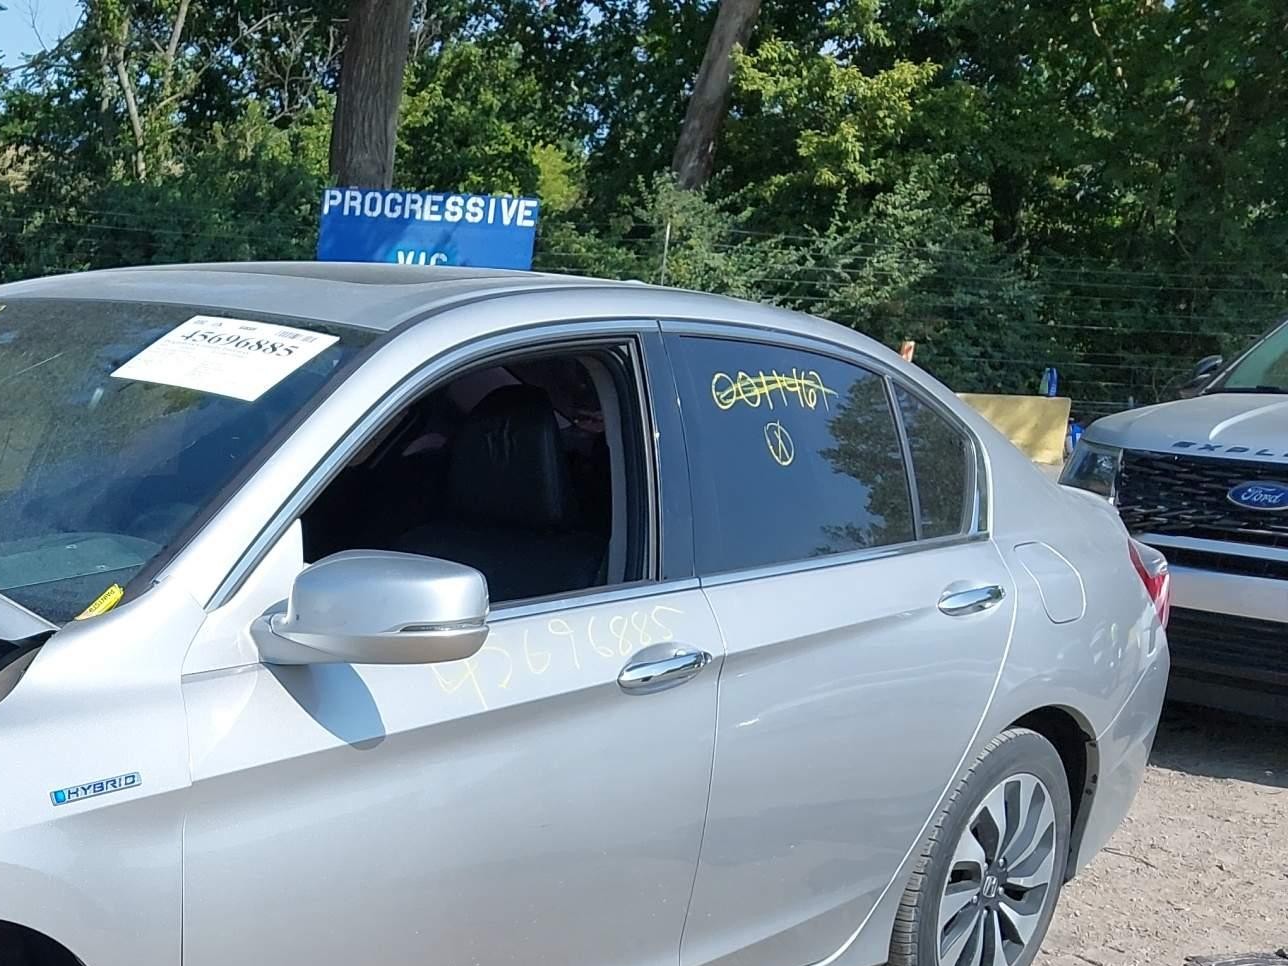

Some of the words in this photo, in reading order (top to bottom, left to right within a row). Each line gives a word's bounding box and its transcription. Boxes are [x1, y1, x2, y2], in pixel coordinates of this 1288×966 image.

[323, 189, 538, 227] PROGRESSIVE
[181, 329, 299, 357] 45696885
[1241, 486, 1285, 504] Ford
[67, 774, 136, 800] HYBRID
